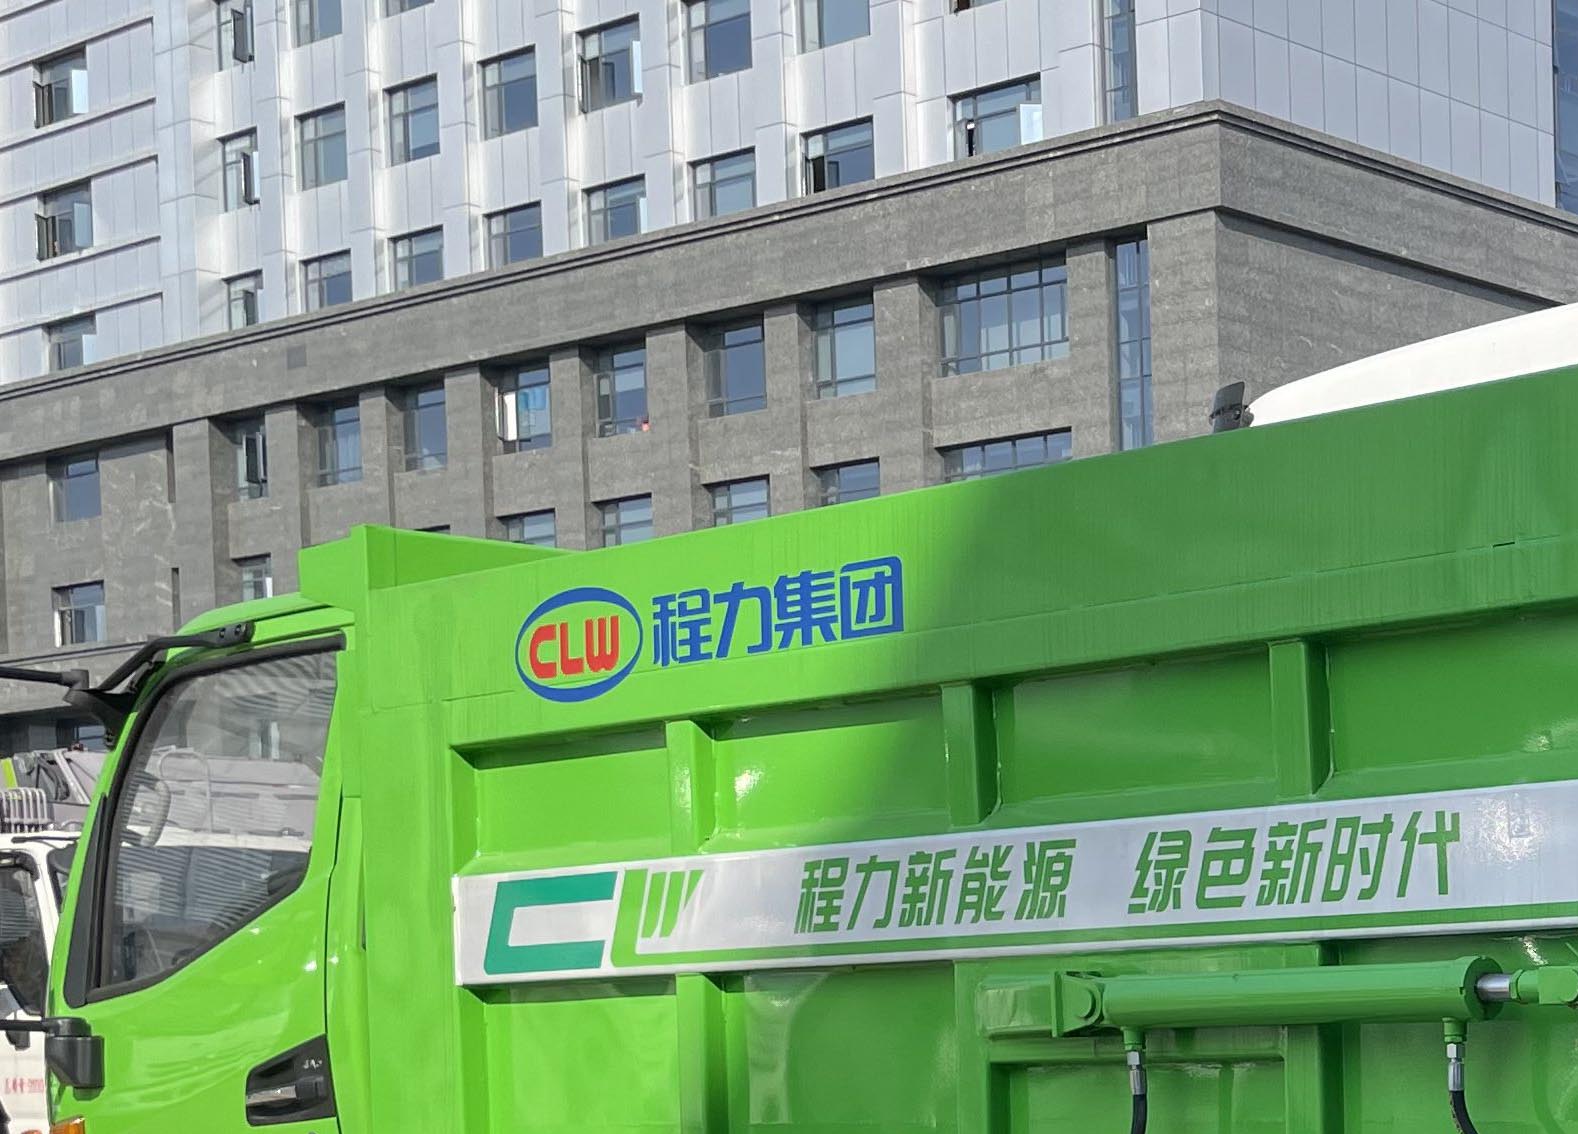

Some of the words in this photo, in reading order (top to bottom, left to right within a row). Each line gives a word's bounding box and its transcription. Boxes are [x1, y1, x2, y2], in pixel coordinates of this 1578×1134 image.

[529, 615, 619, 679] CLW
[652, 555, 905, 667] 程力集团
[793, 837, 1077, 936] 程力新能源
[1127, 810, 1461, 914] 绿色新时代
